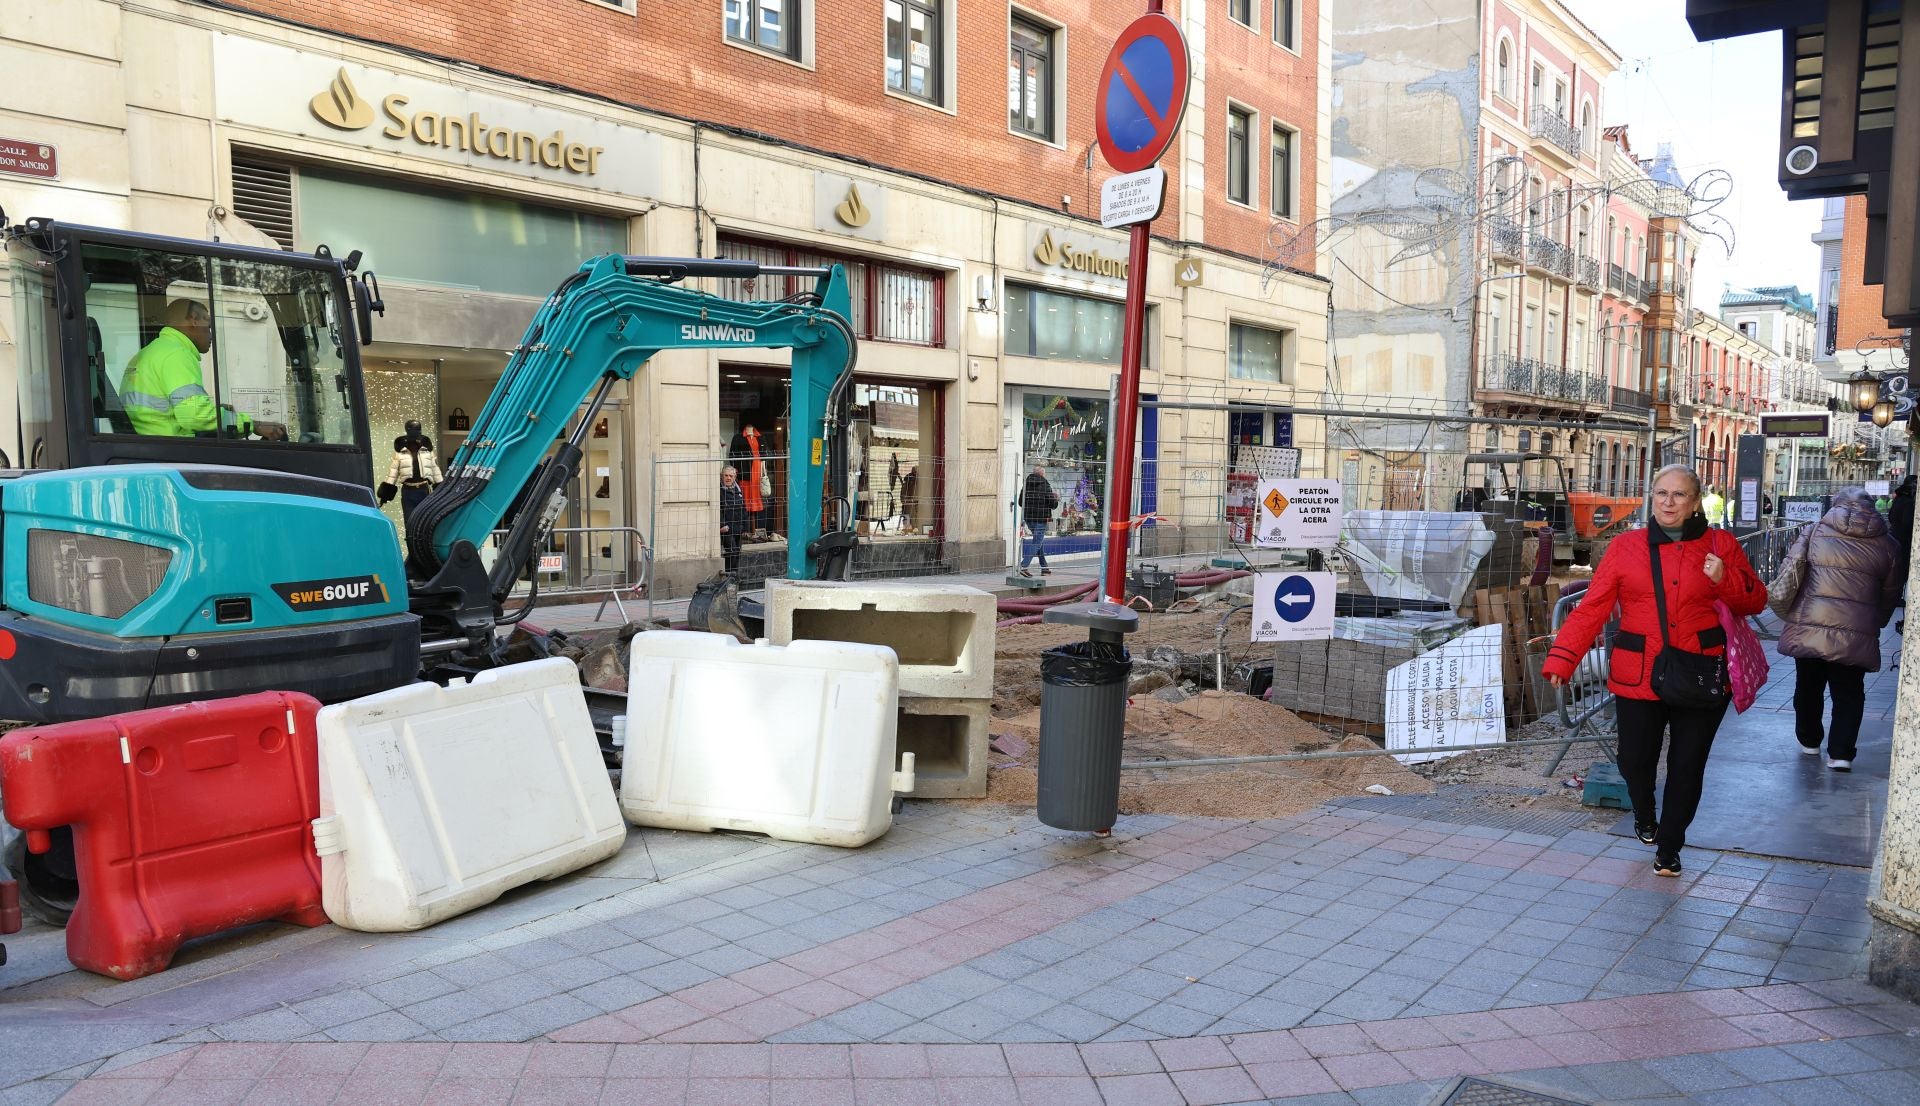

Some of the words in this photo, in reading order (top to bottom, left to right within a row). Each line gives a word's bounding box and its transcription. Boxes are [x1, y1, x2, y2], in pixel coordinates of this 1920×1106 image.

[382, 94, 604, 175] Santander
[0, 157, 16, 166] DON
[19, 160, 49, 170] SANCHO
[1117, 181, 1130, 190] LUNES
[1134, 176, 1151, 186] VIERNES
[1103, 212, 1118, 222] EXCEPTO
[1060, 242, 1128, 280] Santan
[681, 323, 756, 342] SUNWARD
[1031, 427, 1050, 458] My
[1052, 417, 1087, 442] Tienda
[1299, 486, 1329, 495] PEATÓN
[290, 582, 369, 604] SWE60UF
[1422, 661, 1430, 687] SALIDA
[1436, 665, 1443, 675] LA
[1435, 676, 1443, 691] POR
[1407, 680, 1416, 726] BERRUGUETE
[1484, 693, 1494, 731] VIACON
[1422, 697, 1430, 730] ACCESO
[1437, 734, 1445, 745] AL
